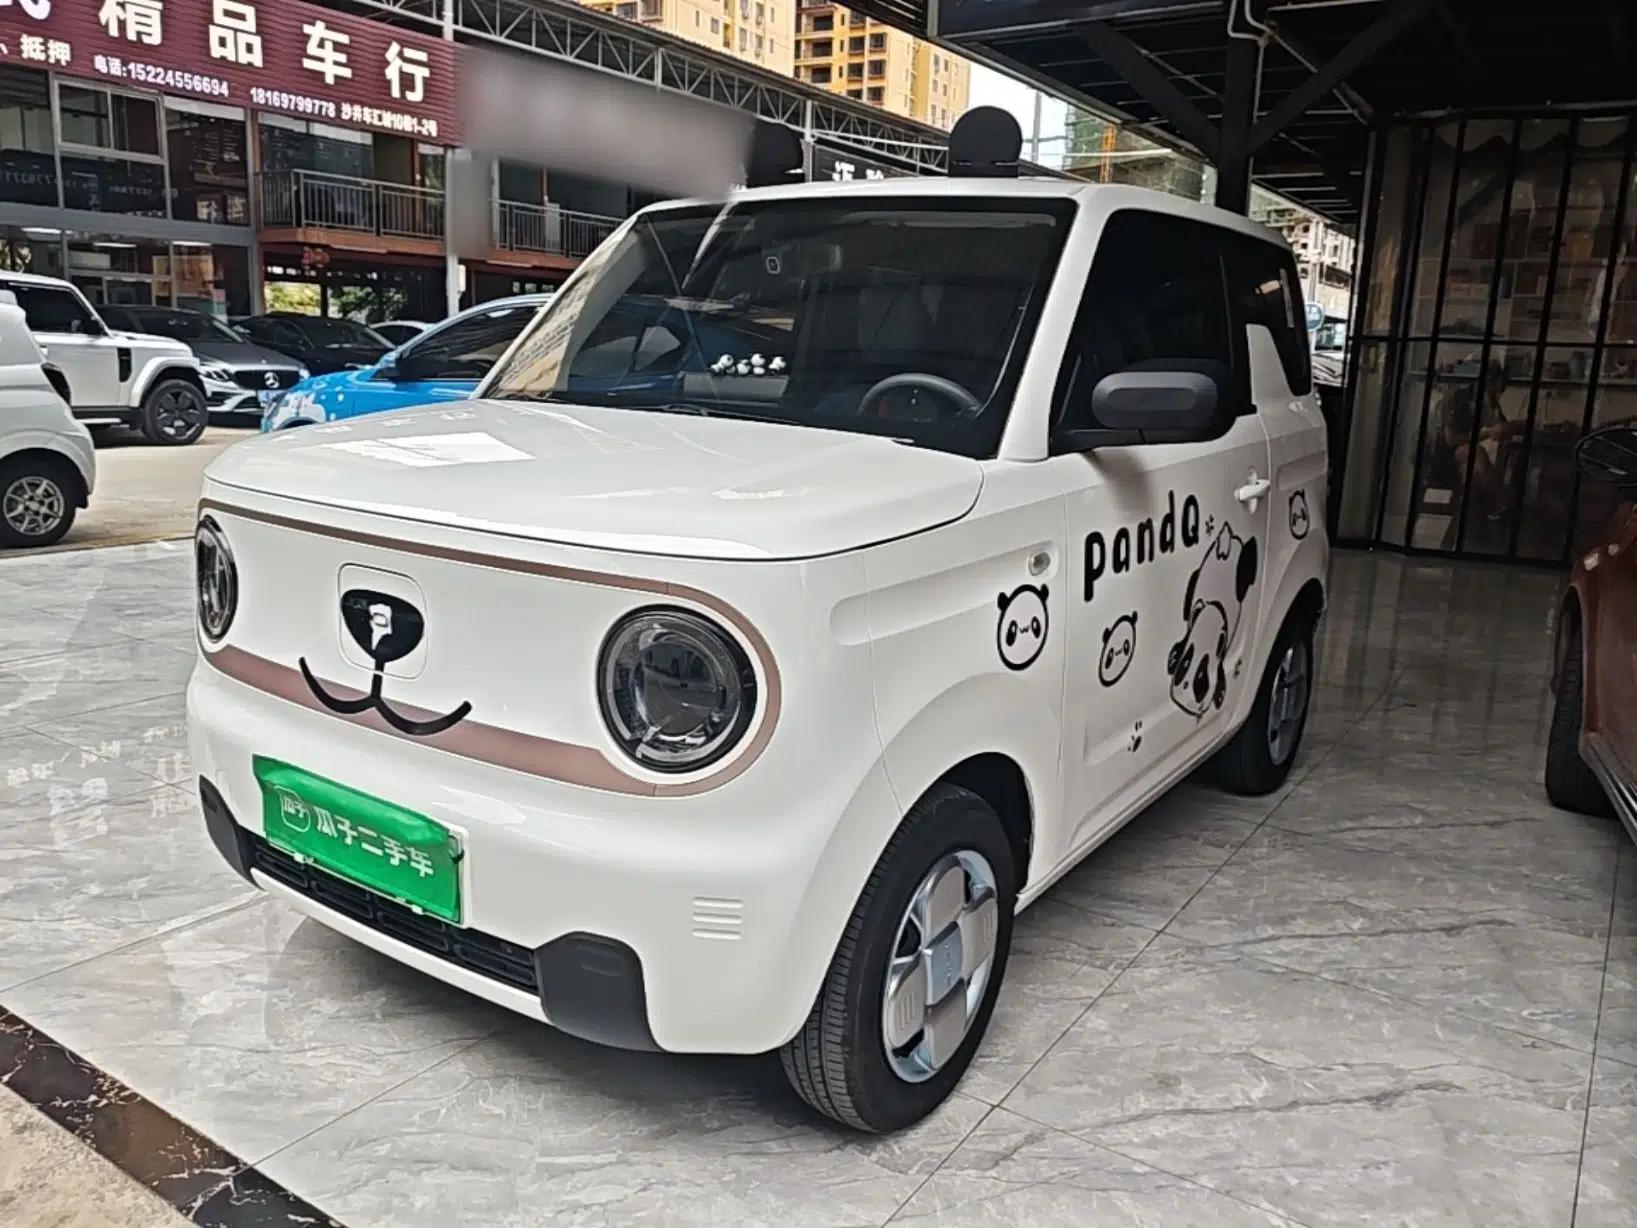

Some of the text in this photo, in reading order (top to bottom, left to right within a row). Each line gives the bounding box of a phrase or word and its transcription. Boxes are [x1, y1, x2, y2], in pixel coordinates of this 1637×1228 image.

[313, 805, 434, 878] 瓜子二手车
